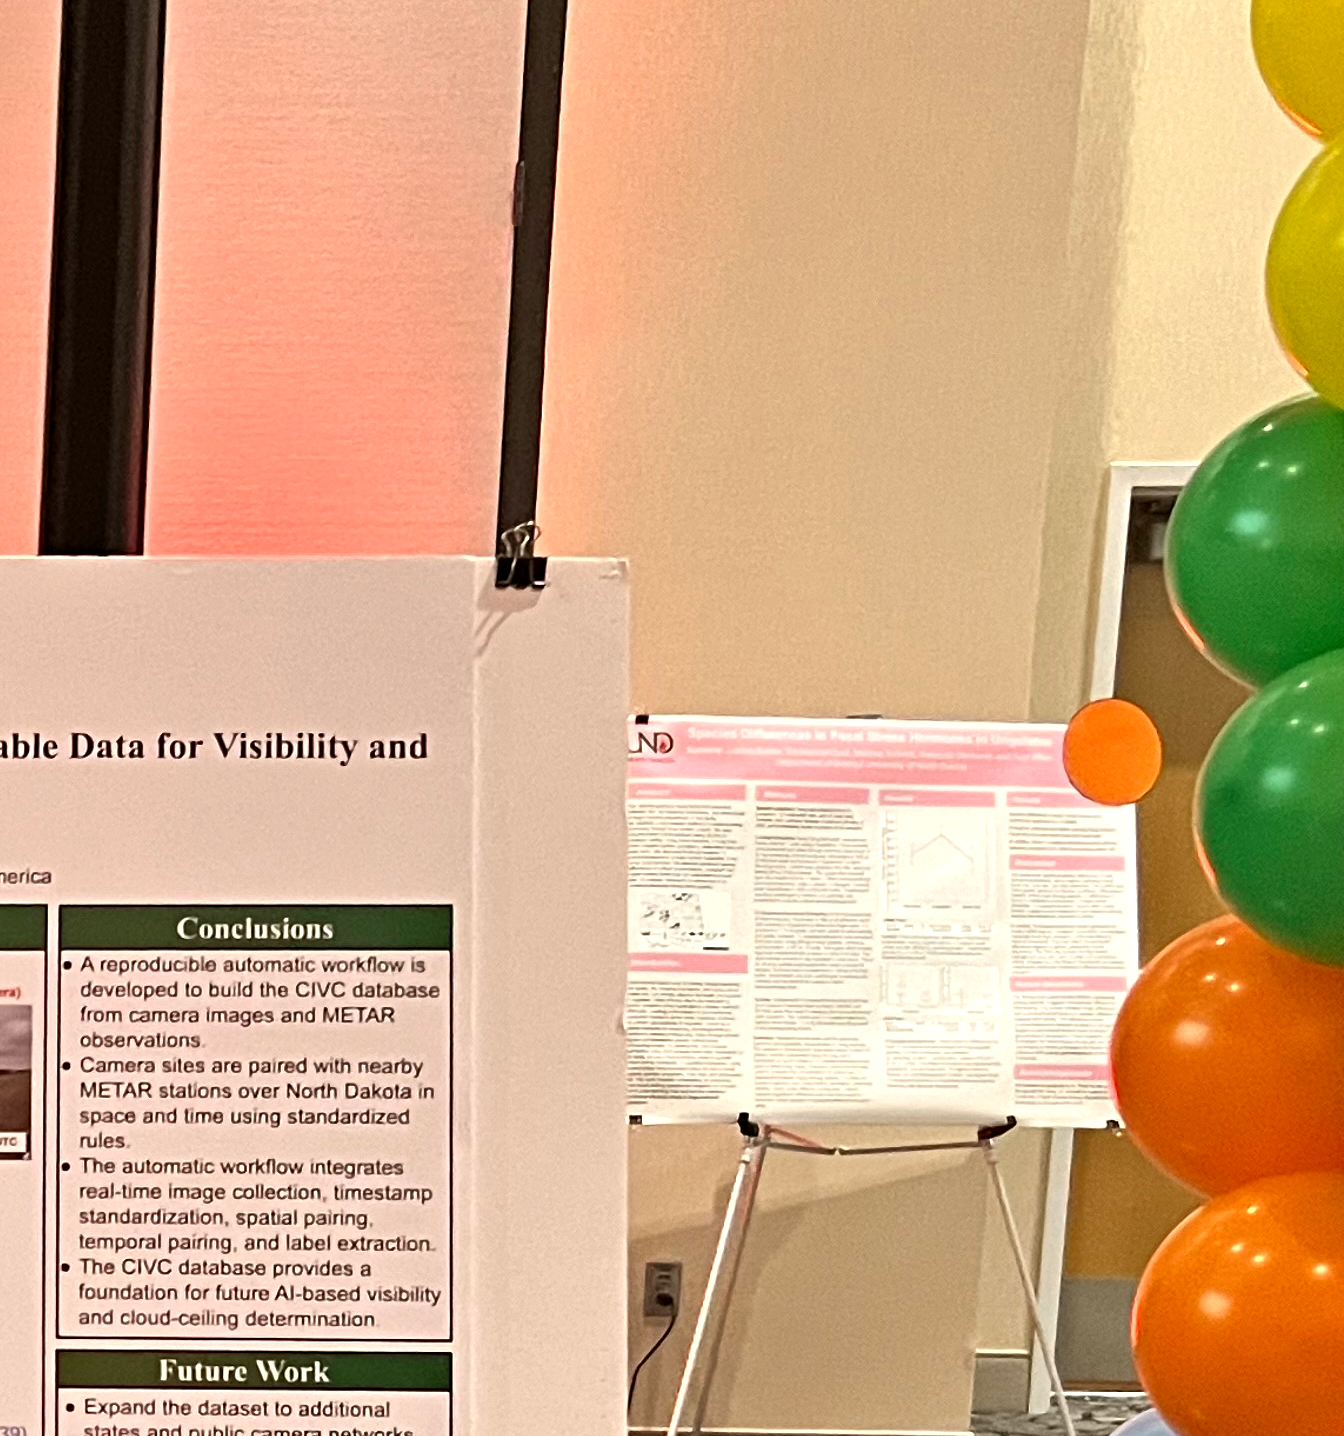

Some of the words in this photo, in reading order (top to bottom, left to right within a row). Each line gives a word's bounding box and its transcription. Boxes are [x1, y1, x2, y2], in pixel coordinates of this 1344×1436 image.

[70, 733, 144, 759] Data
[158, 732, 203, 759] for
[214, 733, 357, 766] Visibility
[370, 733, 427, 759] and
[177, 917, 333, 939] Conclusions
[80, 956, 95, 972] A
[101, 956, 216, 976] reproducible
[223, 957, 315, 973] automatic
[322, 956, 405, 973] workflow
[411, 957, 426, 973] is
[160, 1359, 247, 1381] Future
[256, 1360, 329, 1382] Work
